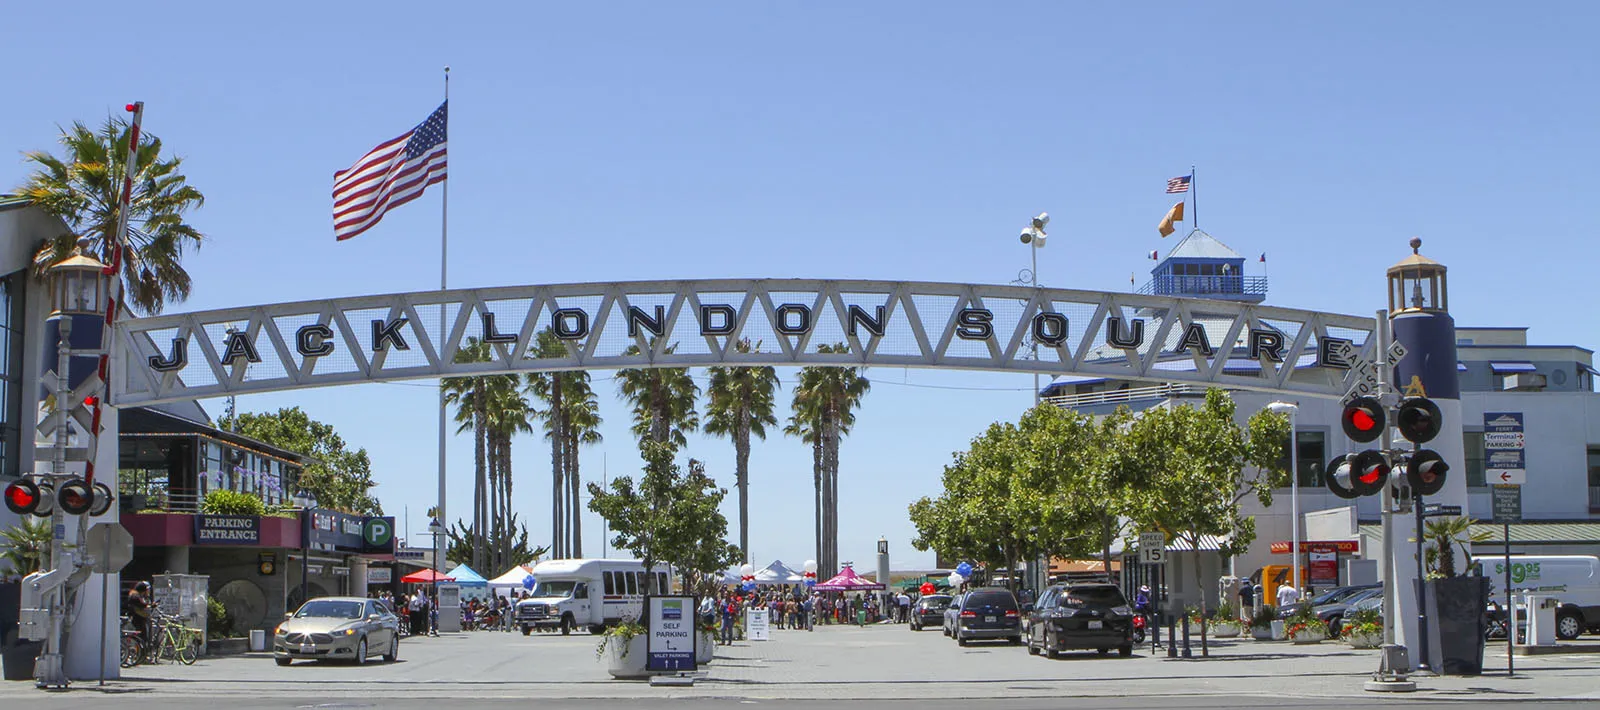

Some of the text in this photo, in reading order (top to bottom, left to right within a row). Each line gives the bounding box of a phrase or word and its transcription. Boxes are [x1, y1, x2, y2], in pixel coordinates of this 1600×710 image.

[148, 303, 1353, 372] JACK LONDON SQUARE
[204, 517, 253, 529] PARKING
[200, 529, 258, 540] ENTRANCE
[371, 524, 386, 542] P
[1144, 548, 1162, 561] 15
